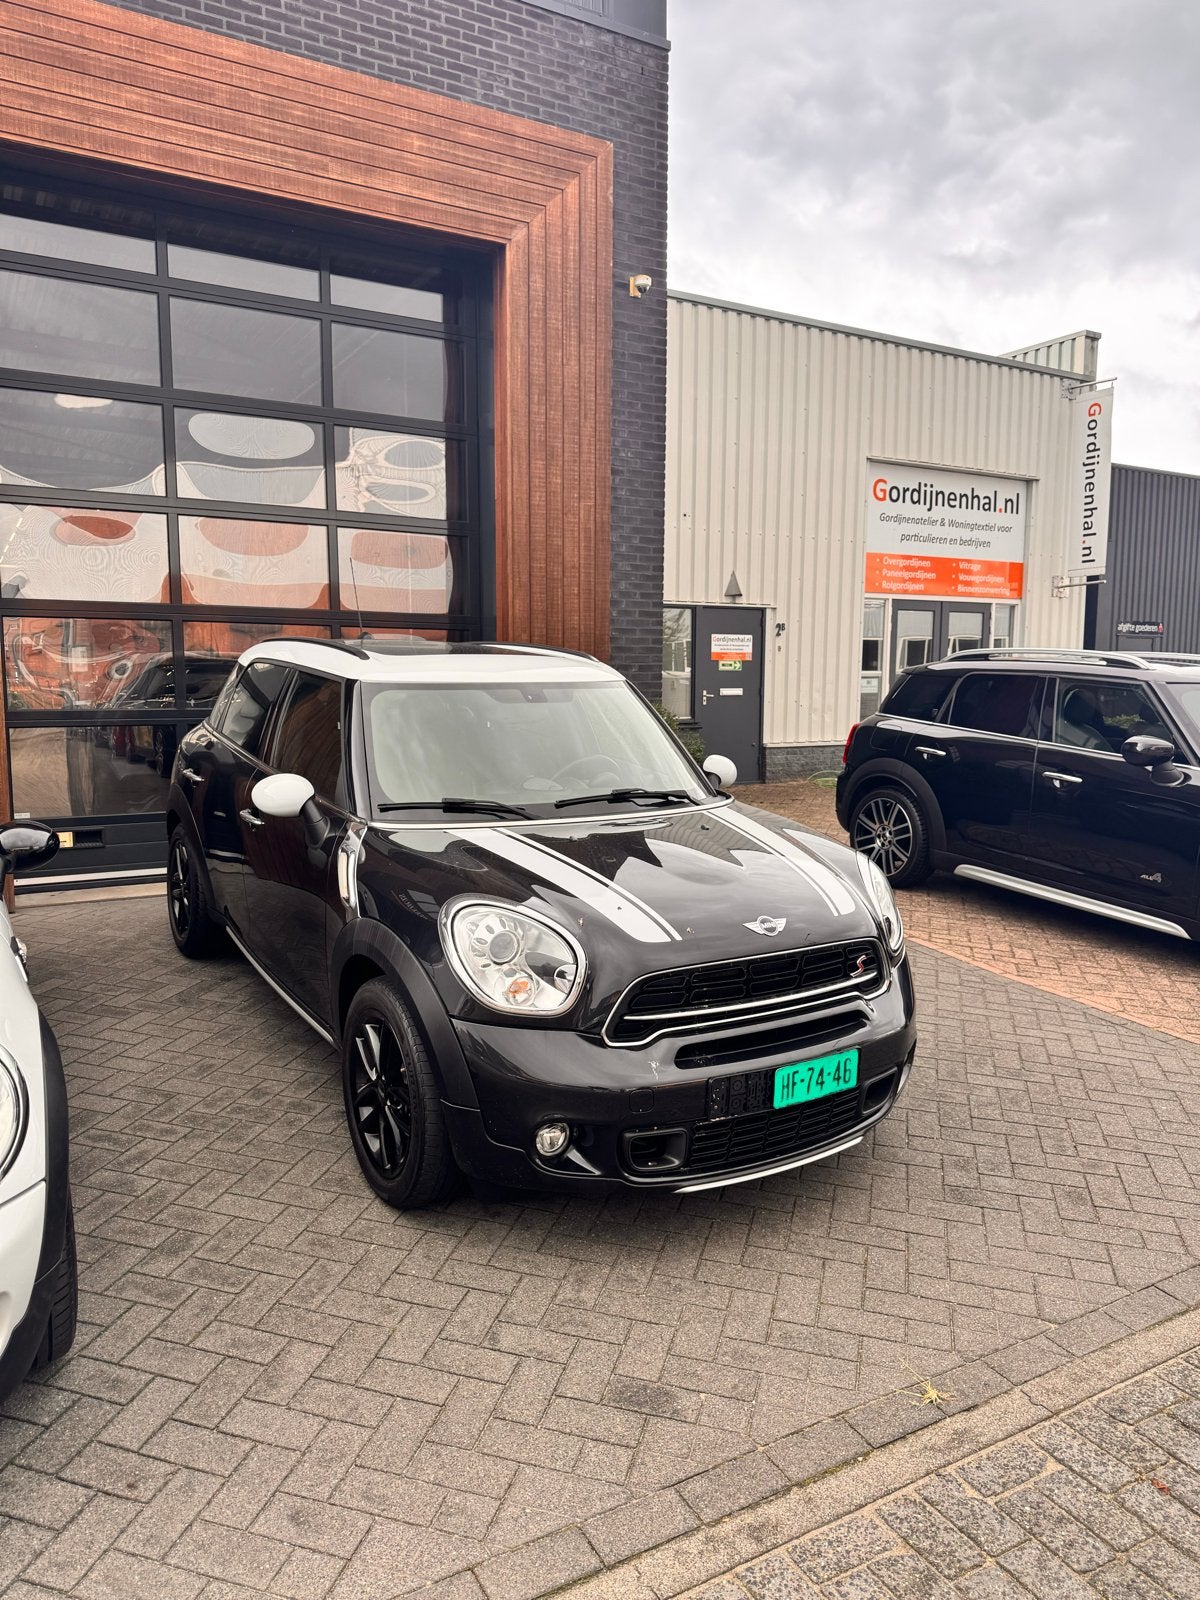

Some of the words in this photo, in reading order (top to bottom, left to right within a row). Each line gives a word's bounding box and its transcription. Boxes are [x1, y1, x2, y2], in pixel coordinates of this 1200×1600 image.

[1081, 402, 1102, 564] Gordijnenhal.nl
[872, 478, 1020, 515] Gordijnenhal.nl
[879, 512, 939, 527] Gordijnenatelier
[940, 517, 946, 527] &
[948, 518, 996, 533] Woningtextiel
[997, 524, 1013, 533] voor
[900, 532, 948, 545] particulieren
[948, 537, 958, 546] en
[958, 537, 991, 549] bedrijven
[883, 556, 931, 568] Overgordijnen
[959, 561, 982, 572] Vitrage
[882, 568, 936, 580] Paneelgordijnen
[780, 1057, 852, 1102] HF-74-46
